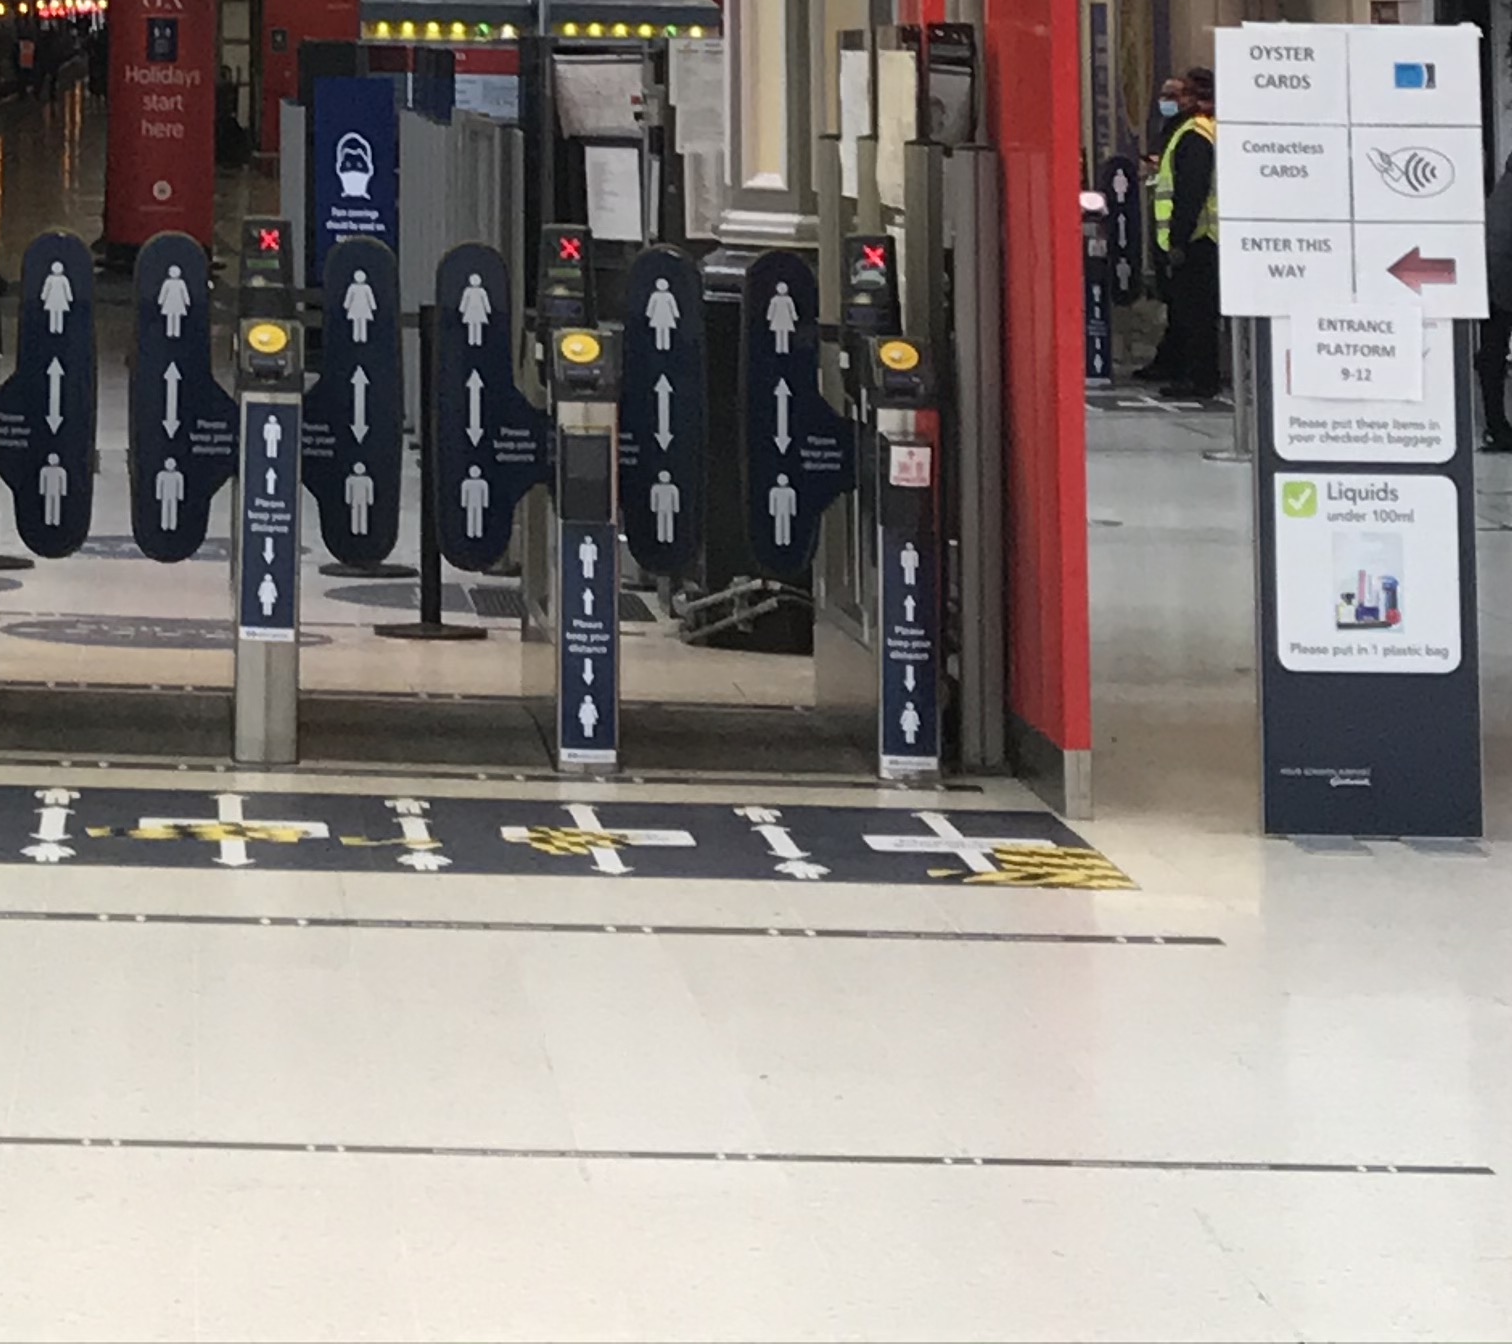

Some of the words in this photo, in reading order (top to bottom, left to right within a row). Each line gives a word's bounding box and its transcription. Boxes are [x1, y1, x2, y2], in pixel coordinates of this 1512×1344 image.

[1249, 45, 1315, 63] OYSTER
[125, 66, 200, 86] Holidays
[1254, 73, 1312, 90] CARDS
[142, 94, 183, 112] start
[141, 119, 184, 138] here
[1243, 141, 1324, 156] Contactless
[1260, 163, 1309, 179] CARDS
[1241, 236, 1292, 253] ENTER
[1296, 237, 1333, 254] THIS
[1269, 263, 1307, 280] WAY
[1318, 318, 1394, 334] ENTRANCE
[1317, 343, 1396, 357] PLATFORM
[1341, 368, 1371, 382] 9-12
[1327, 482, 1399, 504] Liquids
[1327, 511, 1366, 522] under
[1373, 510, 1414, 523] 100ml
[1290, 643, 1329, 655] Please
[1425, 645, 1449, 659] bag
